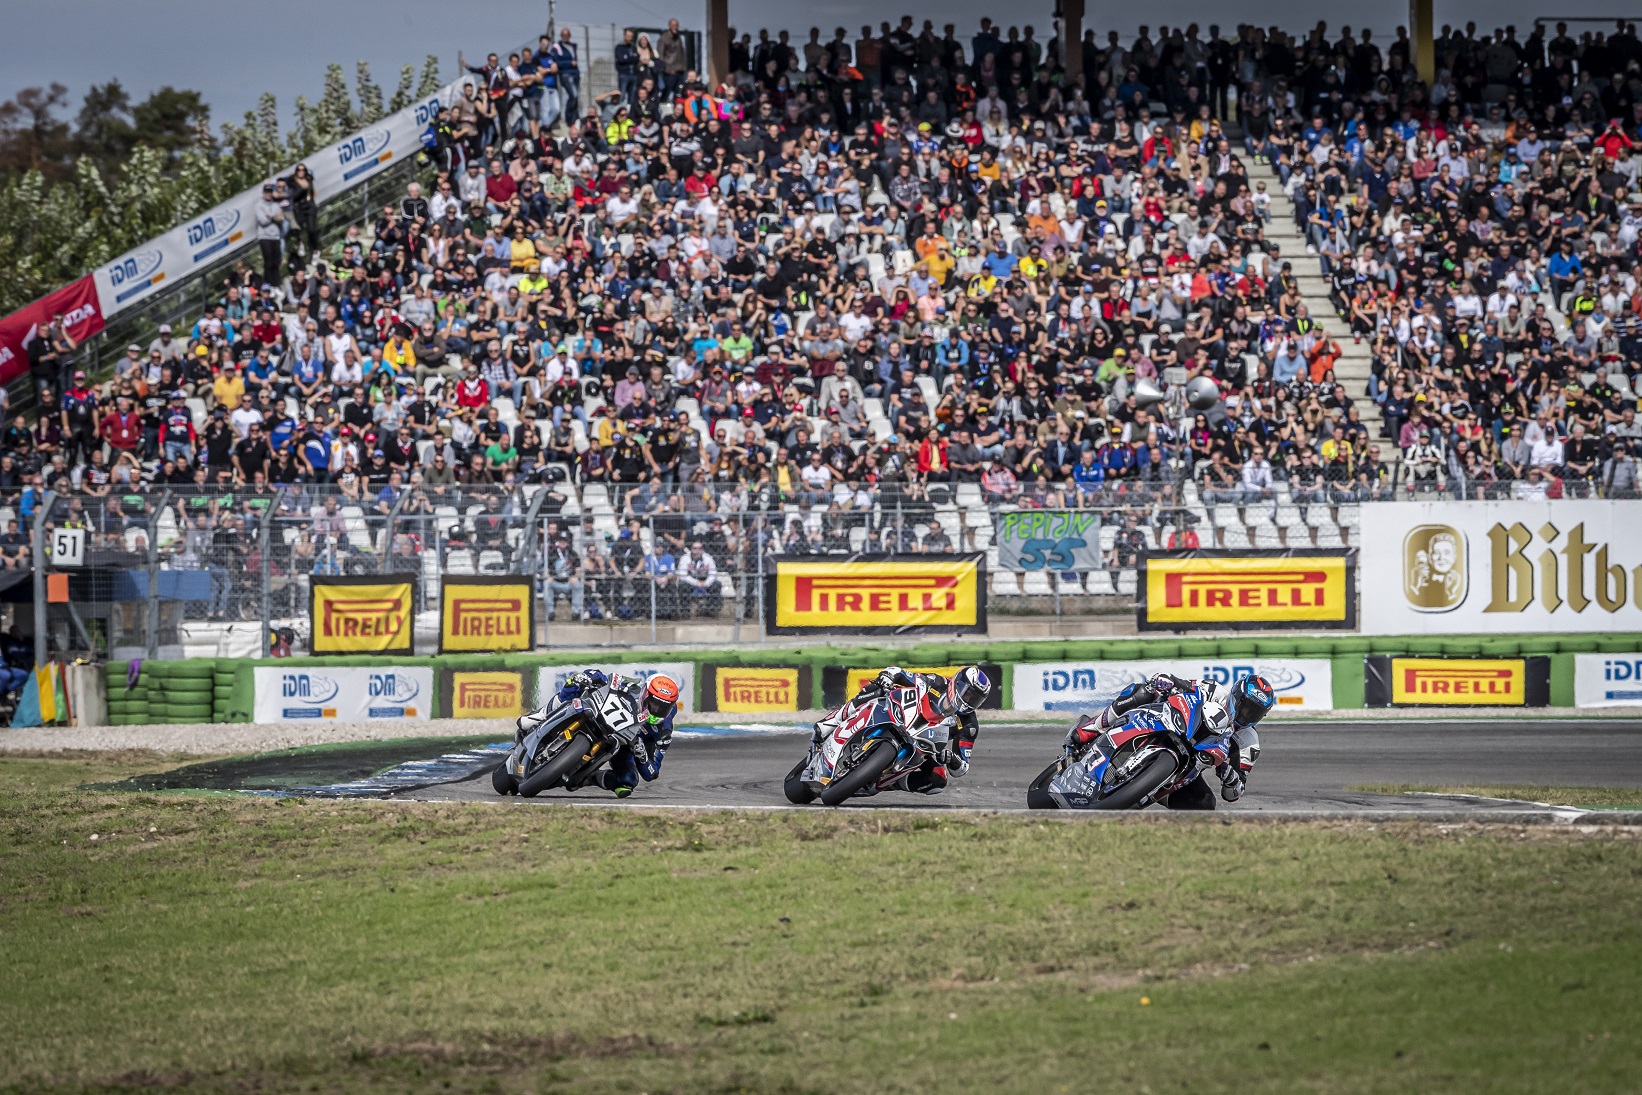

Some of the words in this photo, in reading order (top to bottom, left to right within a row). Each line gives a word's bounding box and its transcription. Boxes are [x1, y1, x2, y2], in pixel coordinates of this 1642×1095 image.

[57, 534, 78, 557] 51
[795, 575, 959, 612] PIRELLI
[1165, 571, 1327, 608] PIRELLI
[323, 598, 403, 637] PIRELLI
[452, 598, 522, 636] PIRELLI
[723, 677, 790, 704] PIRELLI
[1405, 668, 1513, 694] PIRELLI
[459, 681, 516, 709] PIRELLI
[603, 701, 628, 728] 77
[1209, 707, 1227, 728] 1
